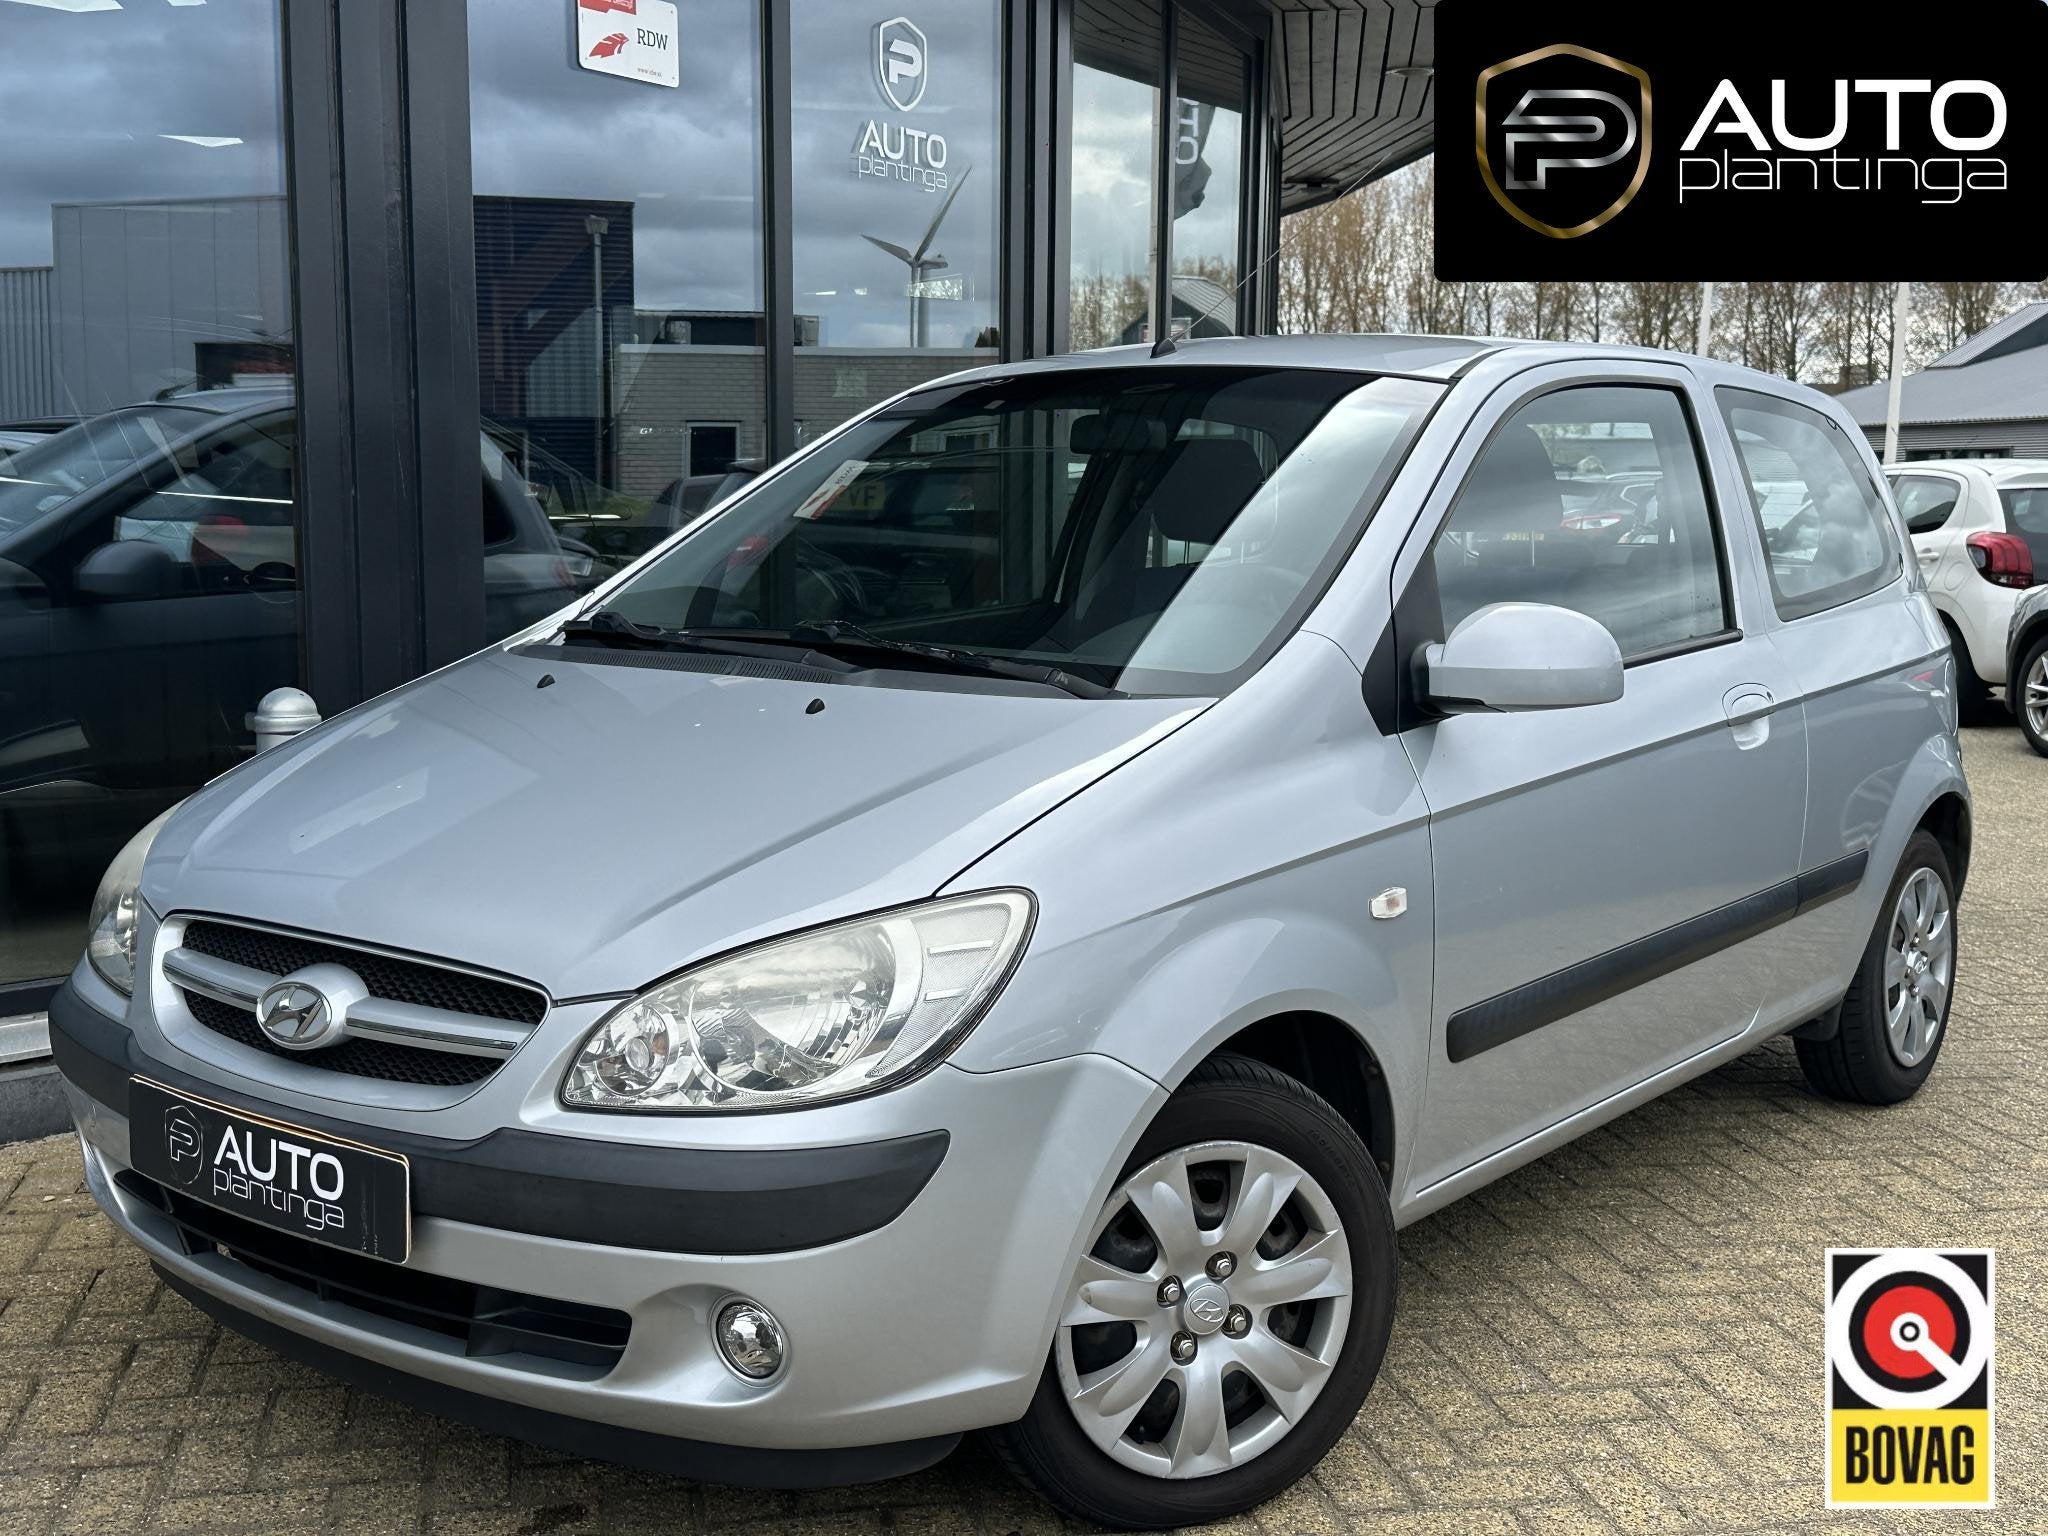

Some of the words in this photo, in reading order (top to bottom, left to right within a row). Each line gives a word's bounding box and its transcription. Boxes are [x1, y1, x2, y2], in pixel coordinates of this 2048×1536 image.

[637, 28, 668, 50] RDW
[860, 119, 946, 168] AUTO
[858, 154, 947, 192] plantinga
[213, 1125, 344, 1200] AUTO
[213, 1167, 344, 1231] plantinga
